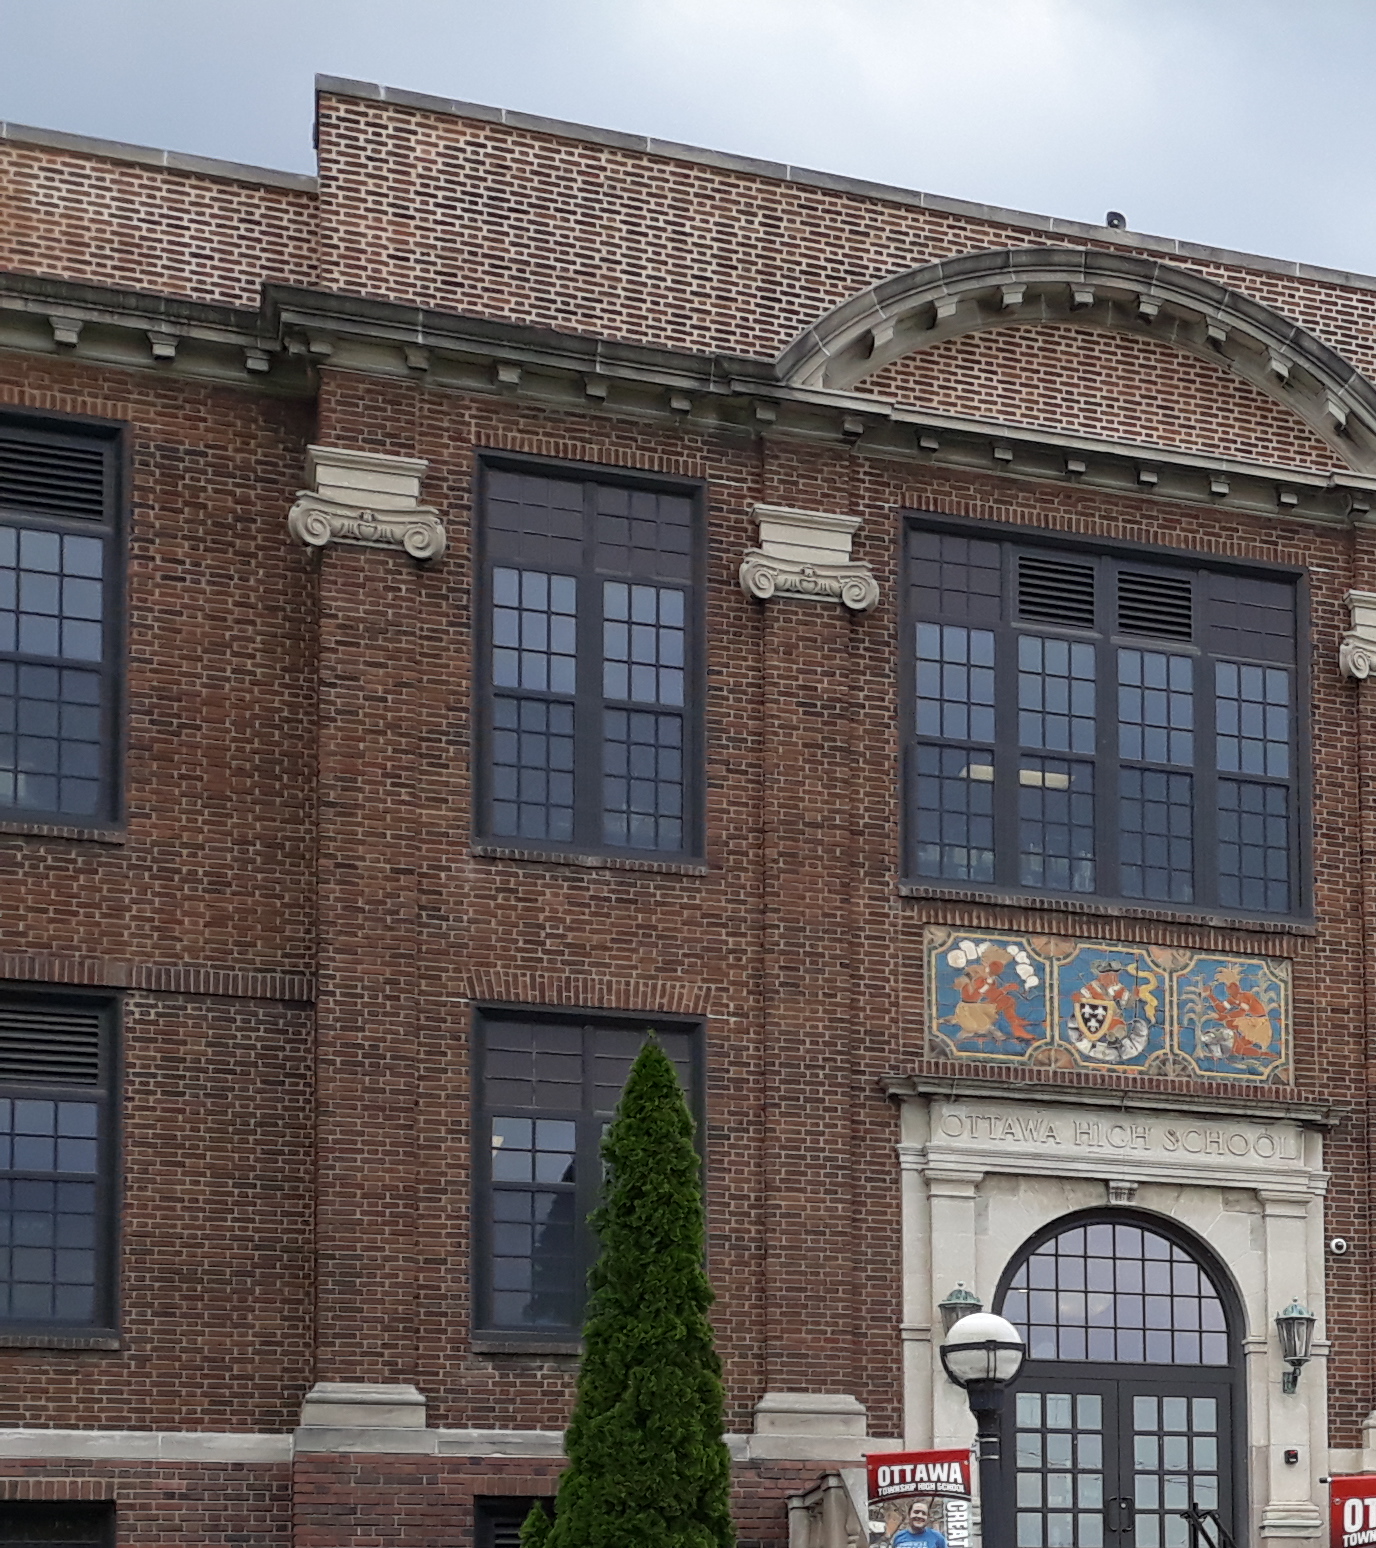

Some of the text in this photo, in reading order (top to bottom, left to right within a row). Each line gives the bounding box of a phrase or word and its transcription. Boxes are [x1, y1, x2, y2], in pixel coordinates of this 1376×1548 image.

[940, 1113, 1298, 1162] OTTAWA HIGH SCHOOL
[877, 1462, 963, 1487] OTTAWA
